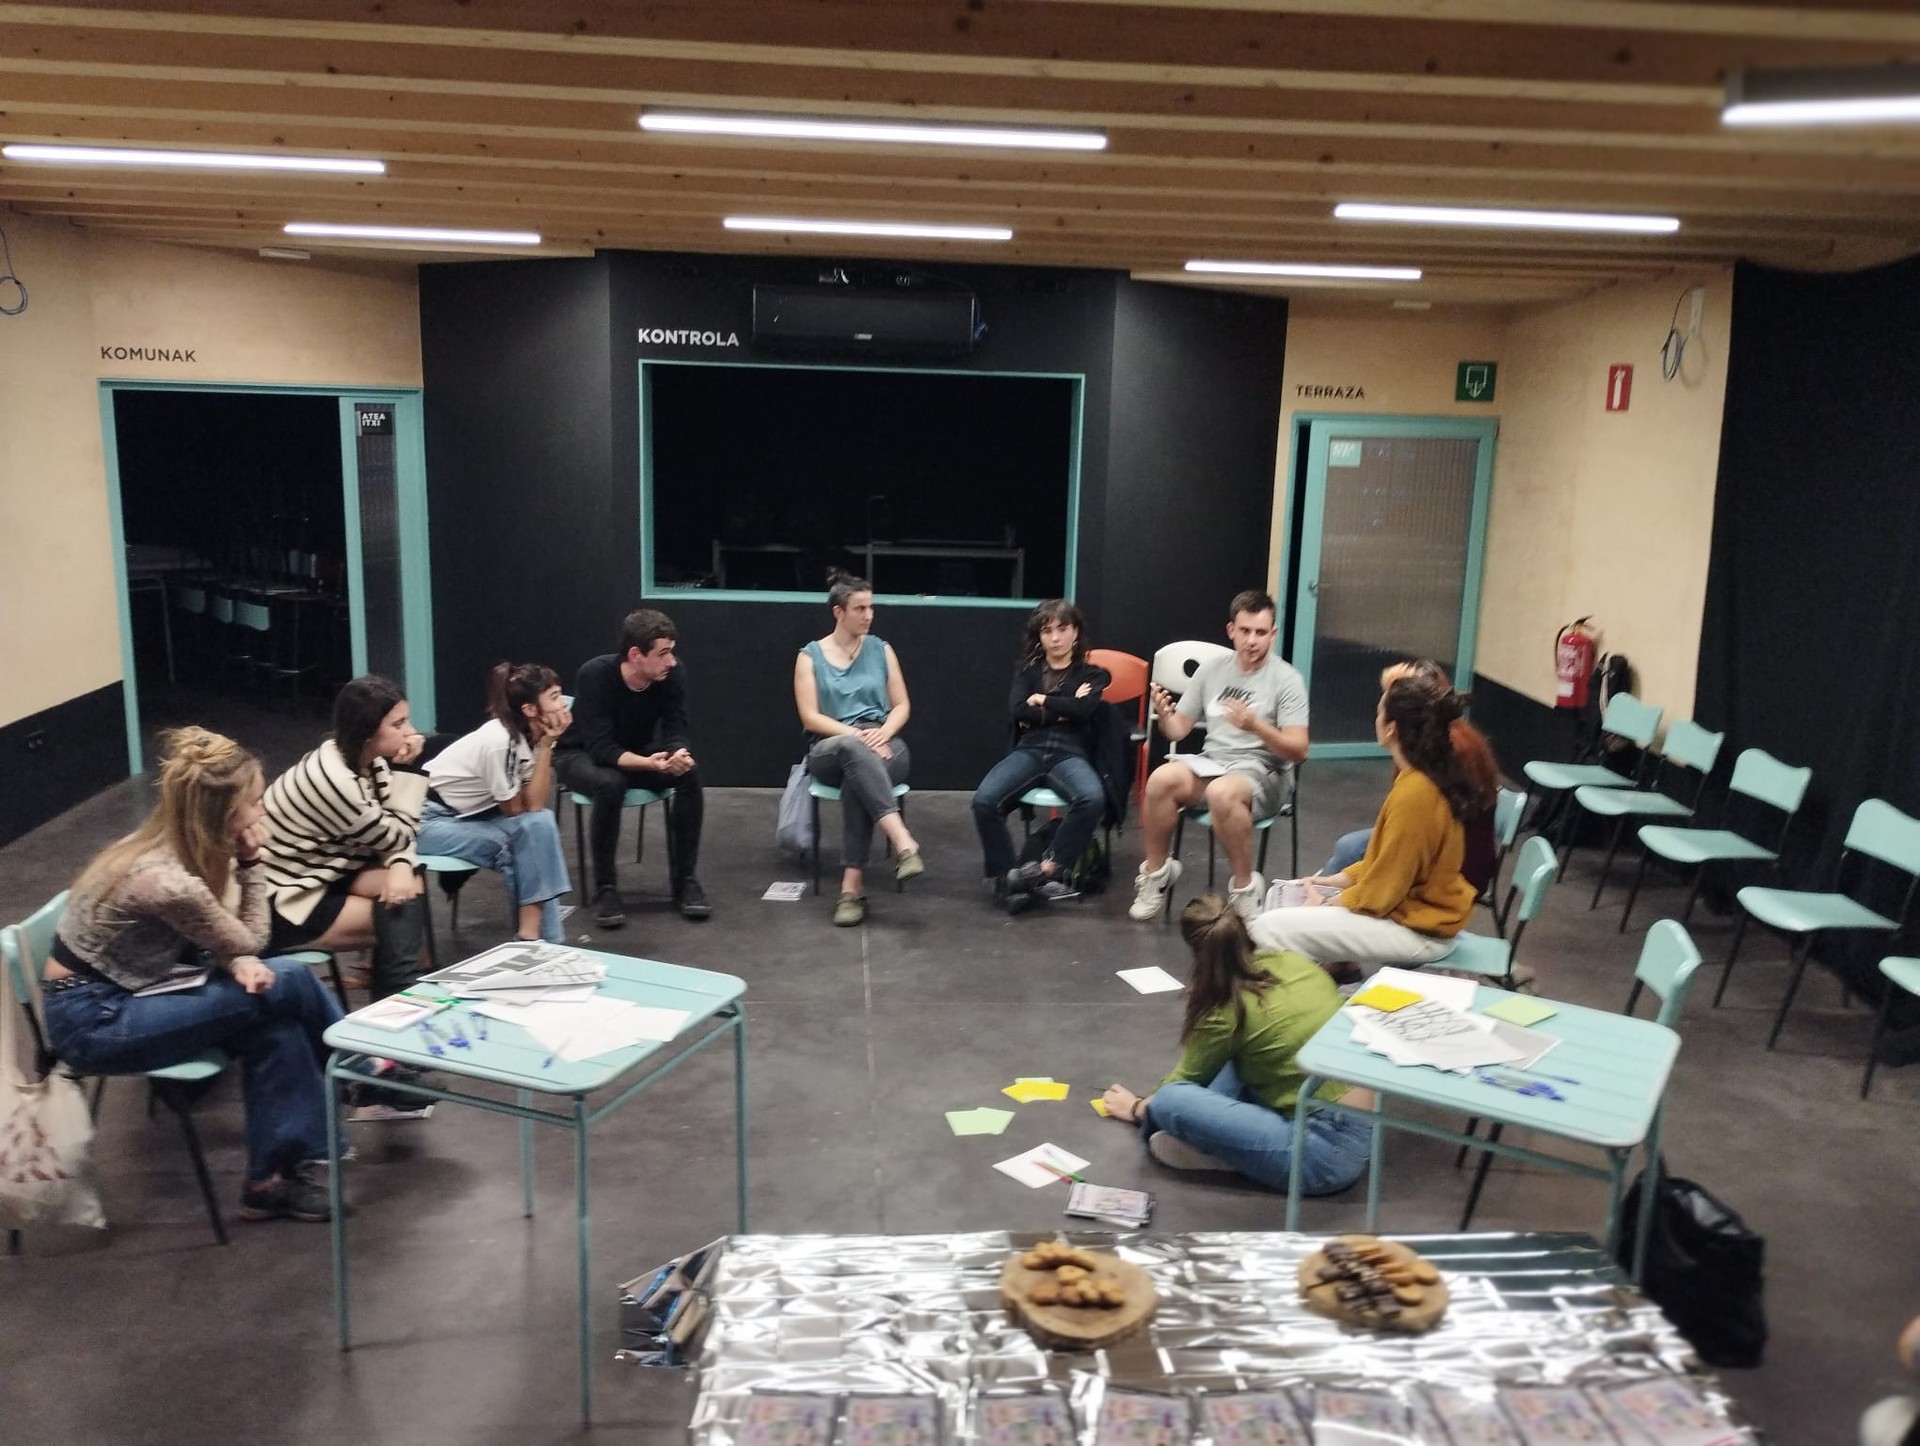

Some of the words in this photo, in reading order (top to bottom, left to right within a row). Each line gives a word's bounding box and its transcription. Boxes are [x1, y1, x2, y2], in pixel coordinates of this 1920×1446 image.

[638, 328, 739, 347] KONTROLA
[100, 346, 196, 363] KOMUNAK
[1295, 383, 1365, 400] TERRAZA
